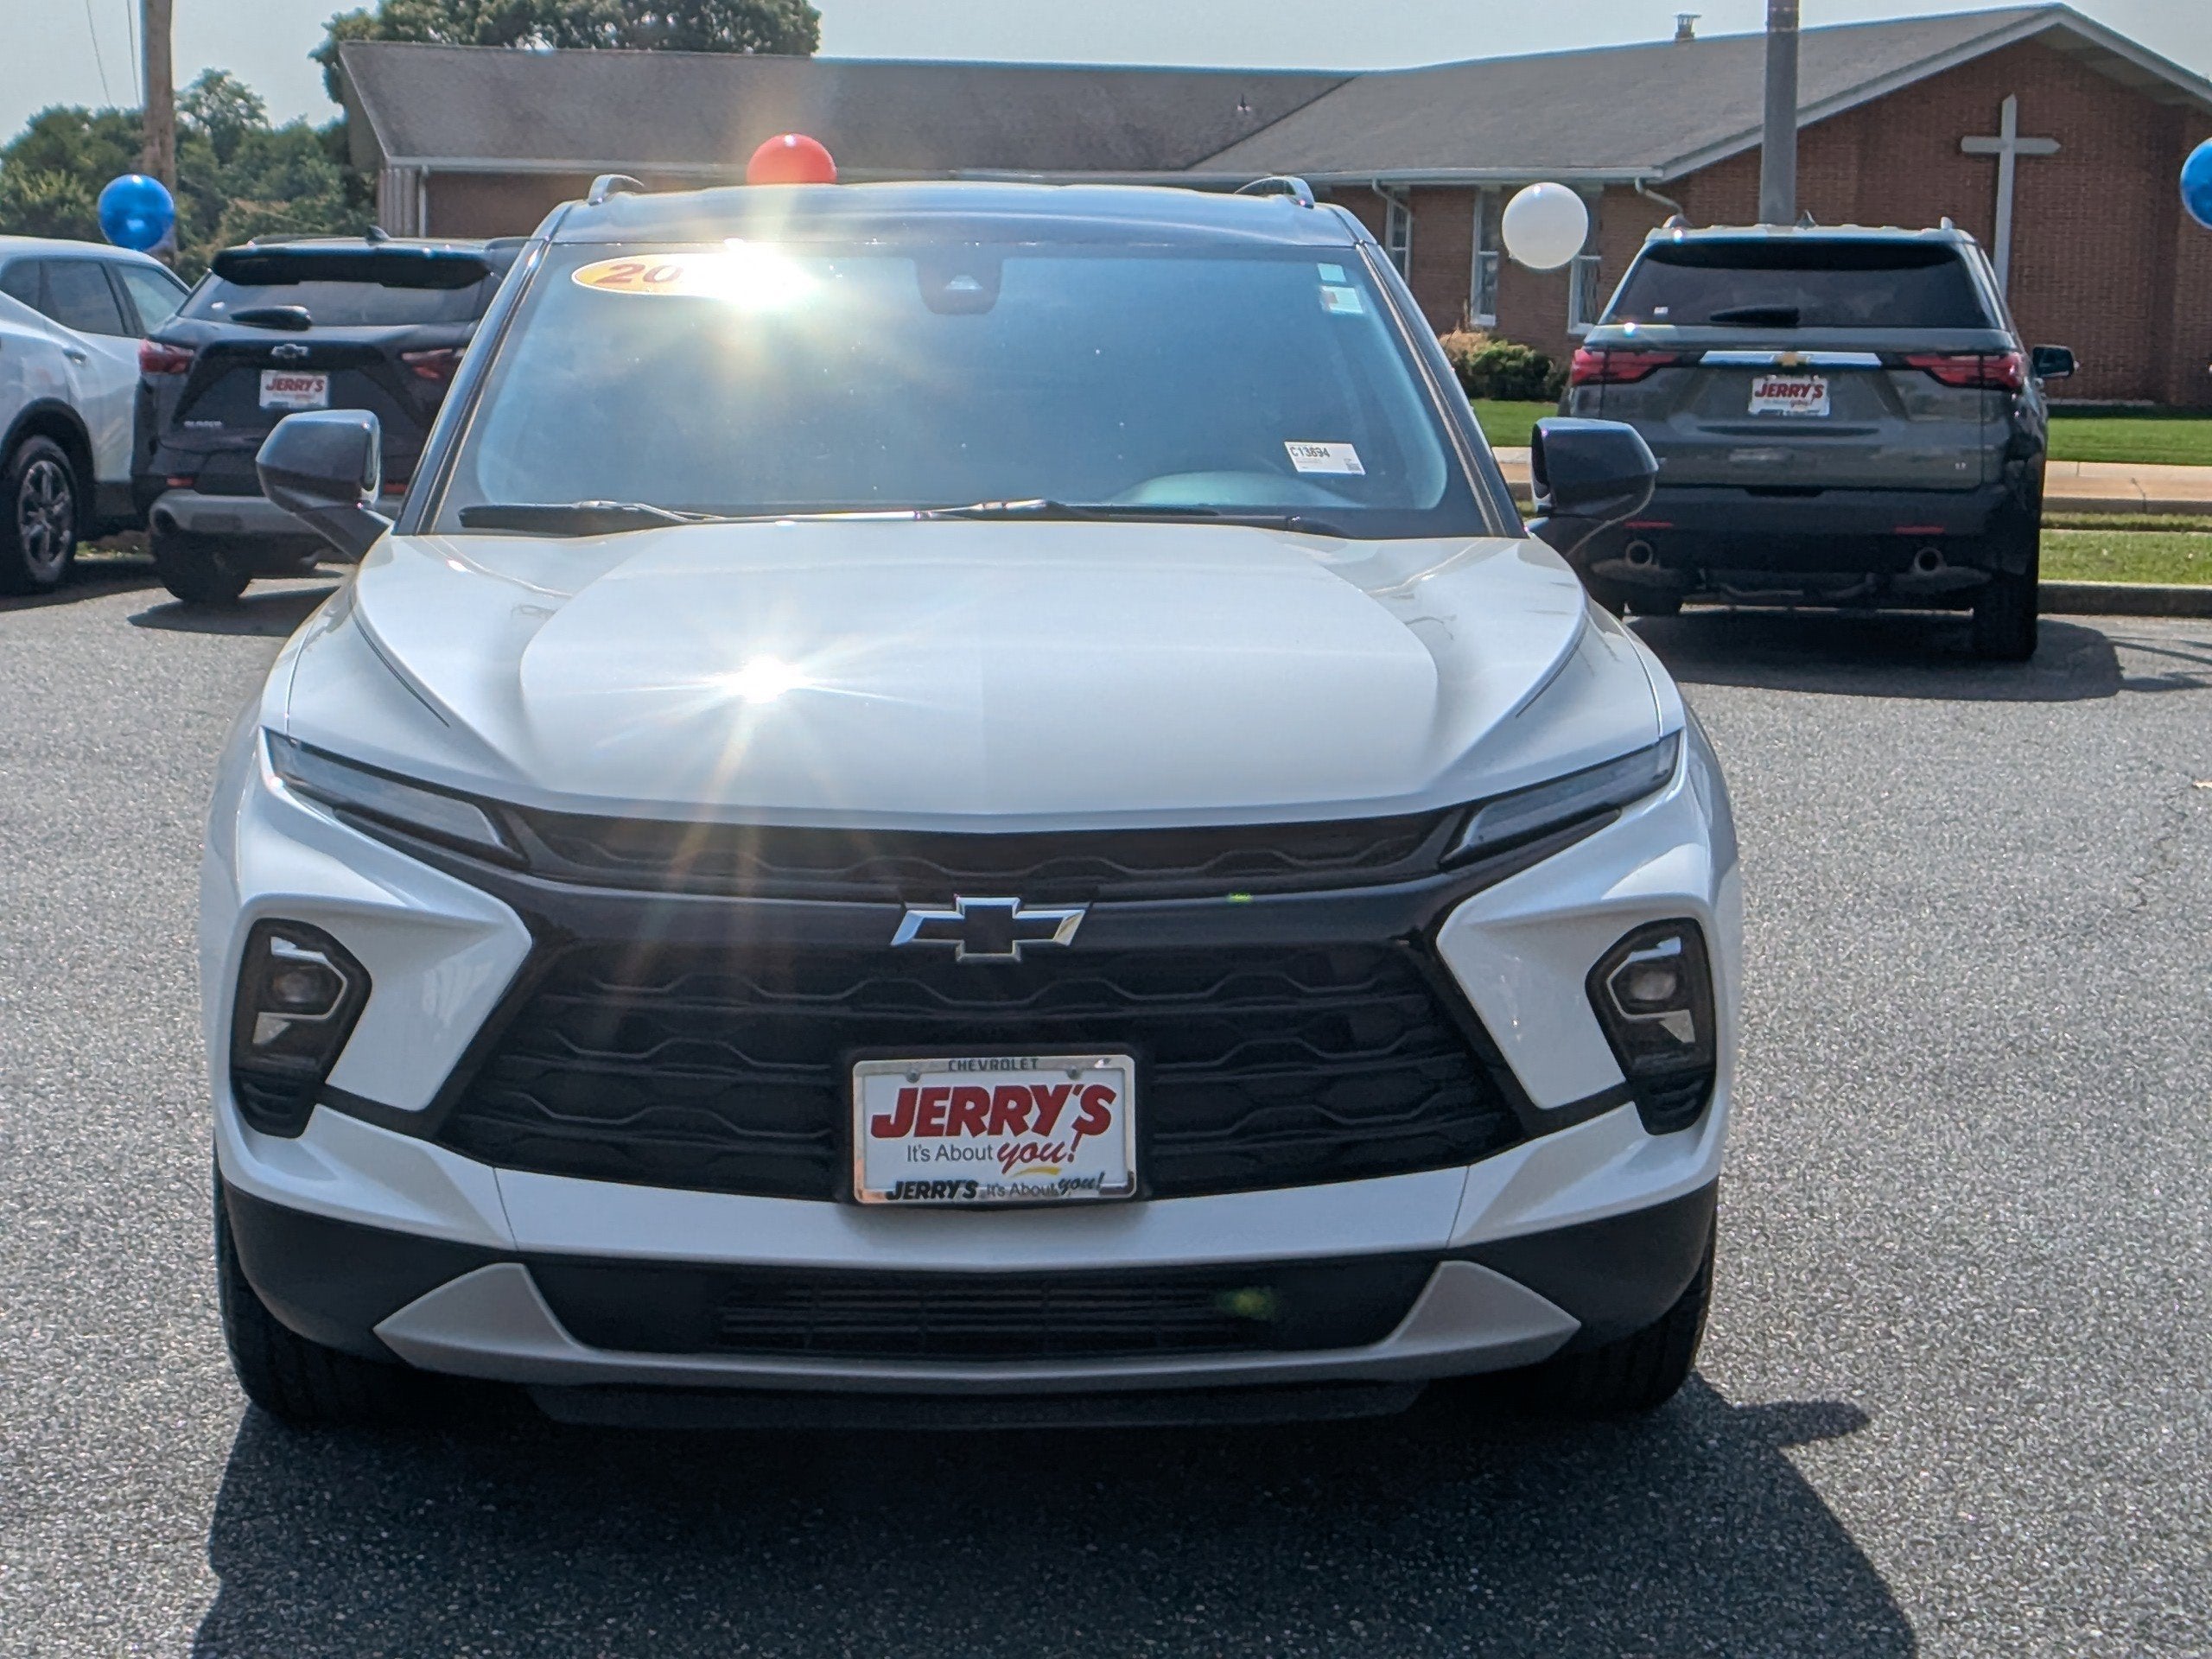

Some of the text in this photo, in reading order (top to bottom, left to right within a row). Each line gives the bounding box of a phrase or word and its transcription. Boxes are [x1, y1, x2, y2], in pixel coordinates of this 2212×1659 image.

[265, 378, 325, 393] JERRY'S
[1754, 383, 1825, 399] JERRY'S
[948, 1058, 1039, 1071] CHEVROLET
[871, 1084, 1117, 1138] JERRY'S
[906, 1131, 1083, 1175] It's About you!
[886, 1179, 979, 1200] JERRY'S
[1009, 1182, 1059, 1198] About
